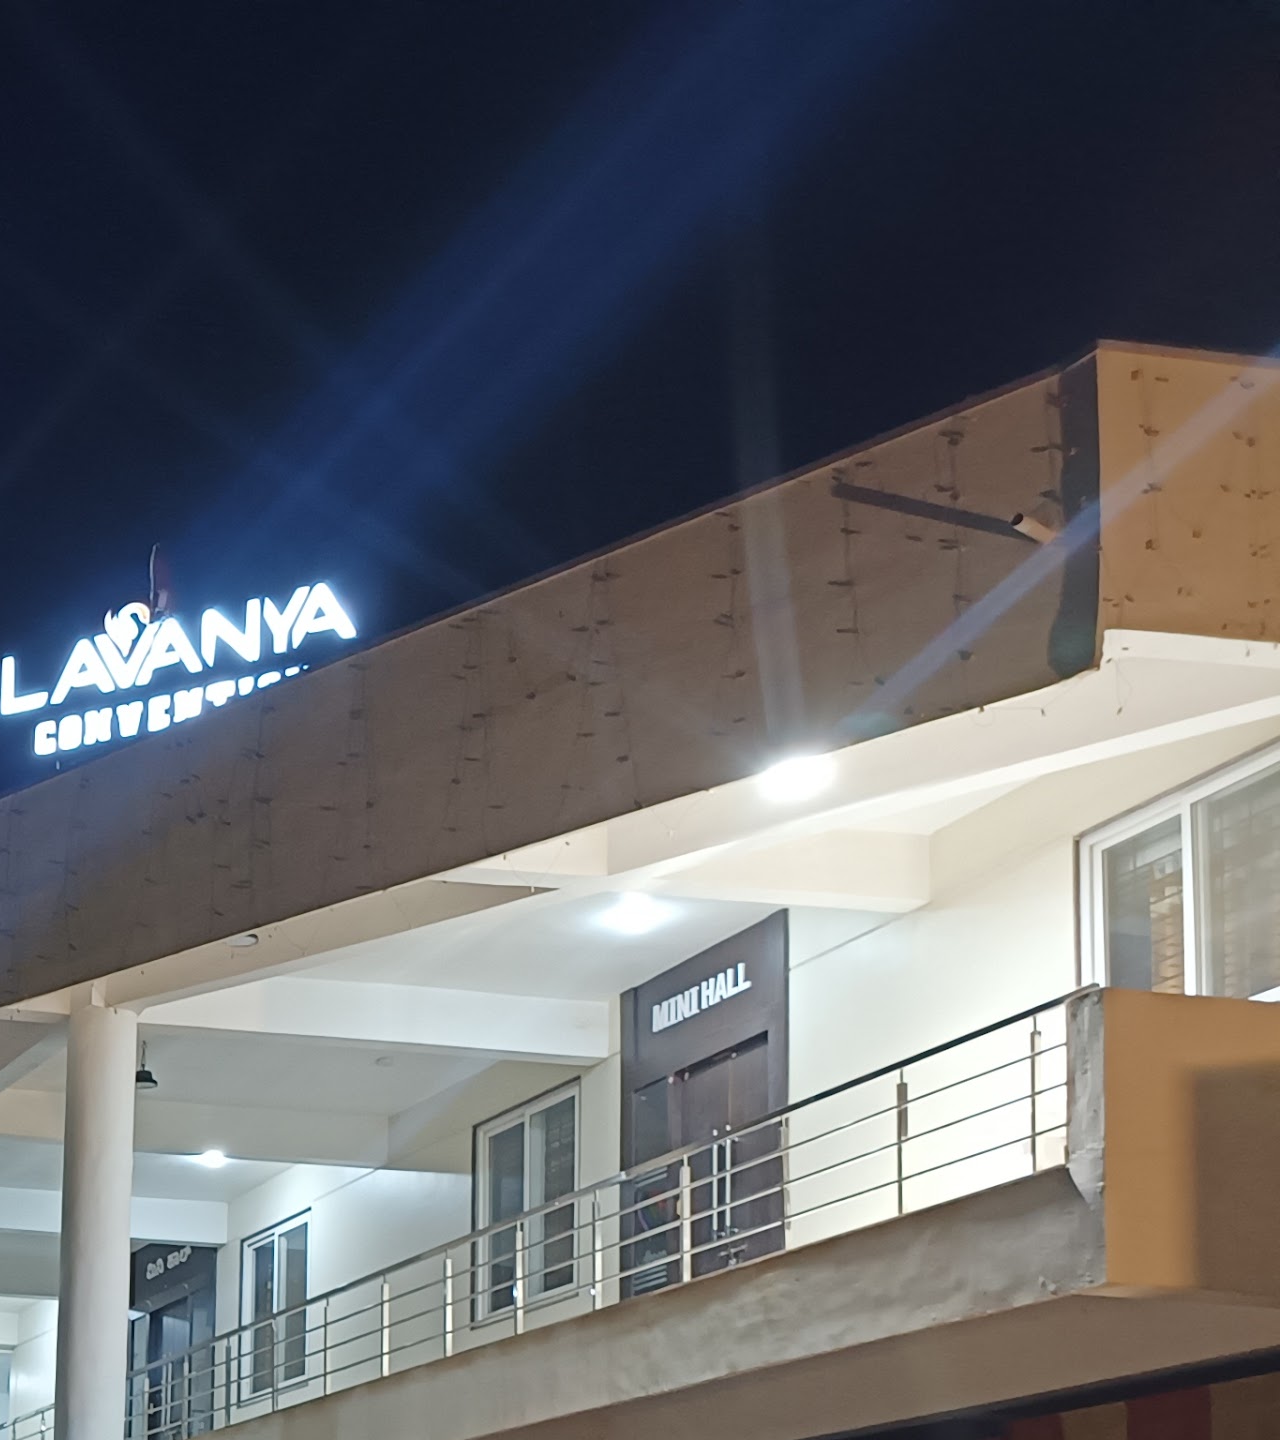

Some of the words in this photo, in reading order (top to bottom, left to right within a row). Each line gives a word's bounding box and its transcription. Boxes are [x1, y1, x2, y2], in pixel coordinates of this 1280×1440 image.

[0, 581, 357, 716] LAVANYA
[652, 985, 700, 1032] MINI
[701, 962, 752, 1009] HALL
